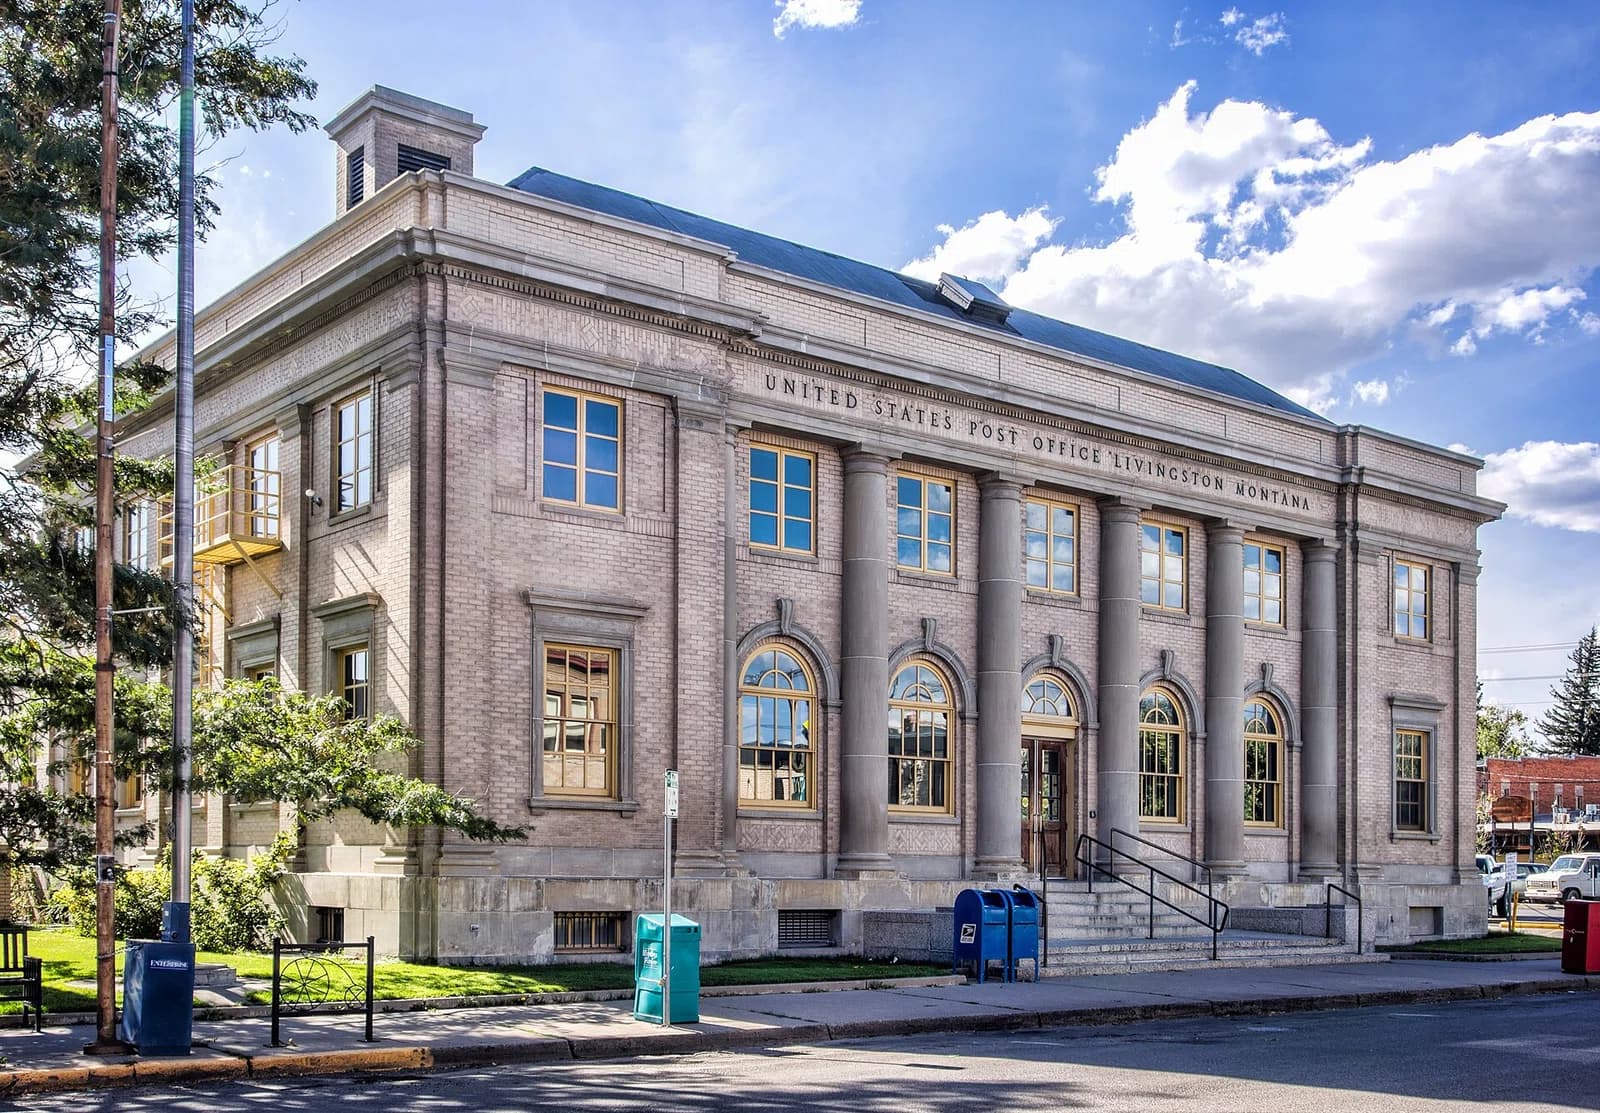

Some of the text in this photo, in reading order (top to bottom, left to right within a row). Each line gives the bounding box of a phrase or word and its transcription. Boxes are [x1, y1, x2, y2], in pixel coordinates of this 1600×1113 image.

[765, 374, 1311, 511] UNITED STATES POST OFFICE LIVINGSTON MONTANA
